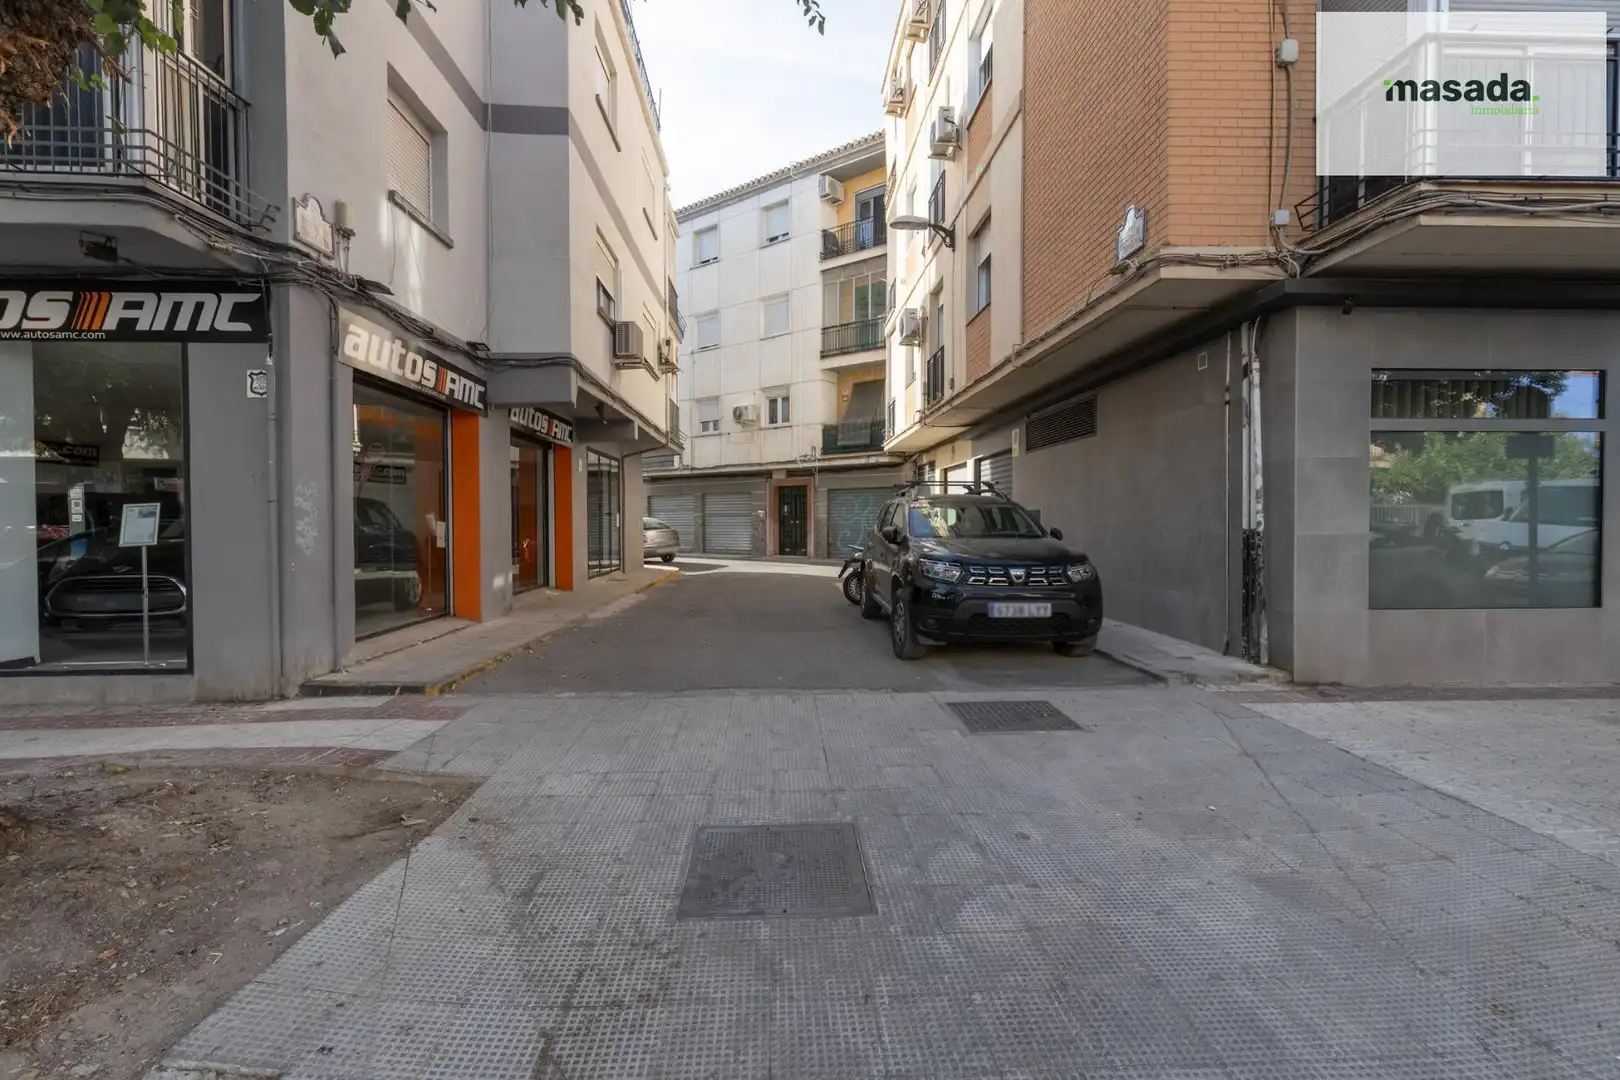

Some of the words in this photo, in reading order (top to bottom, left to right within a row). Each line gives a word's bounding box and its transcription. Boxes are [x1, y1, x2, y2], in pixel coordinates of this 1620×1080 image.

[102, 292, 261, 331] AMC
[344, 324, 438, 388] autos
[445, 369, 485, 409] AMC
[552, 419, 572, 442] AMC
